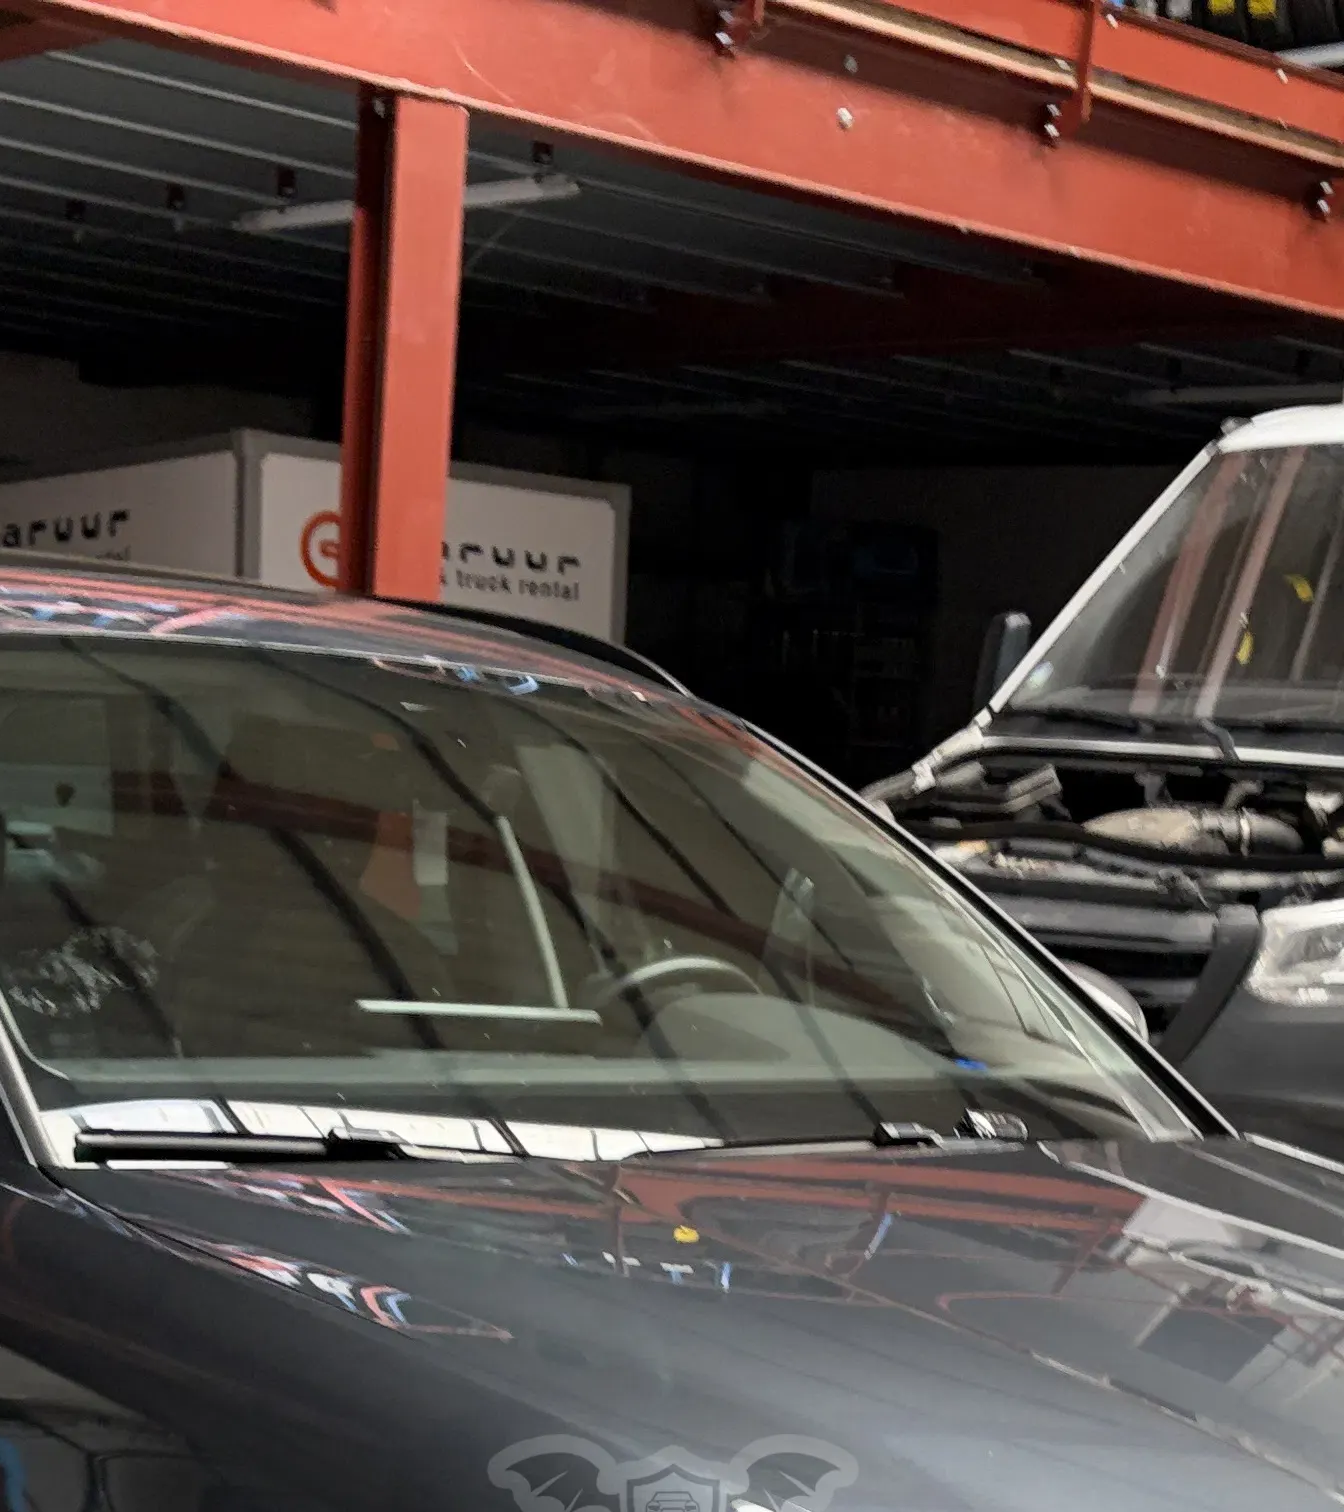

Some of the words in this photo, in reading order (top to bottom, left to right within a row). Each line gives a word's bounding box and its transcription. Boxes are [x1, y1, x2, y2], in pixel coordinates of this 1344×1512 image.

[440, 539, 580, 575] ruur
[456, 569, 512, 594] truck
[519, 578, 580, 601] rental
